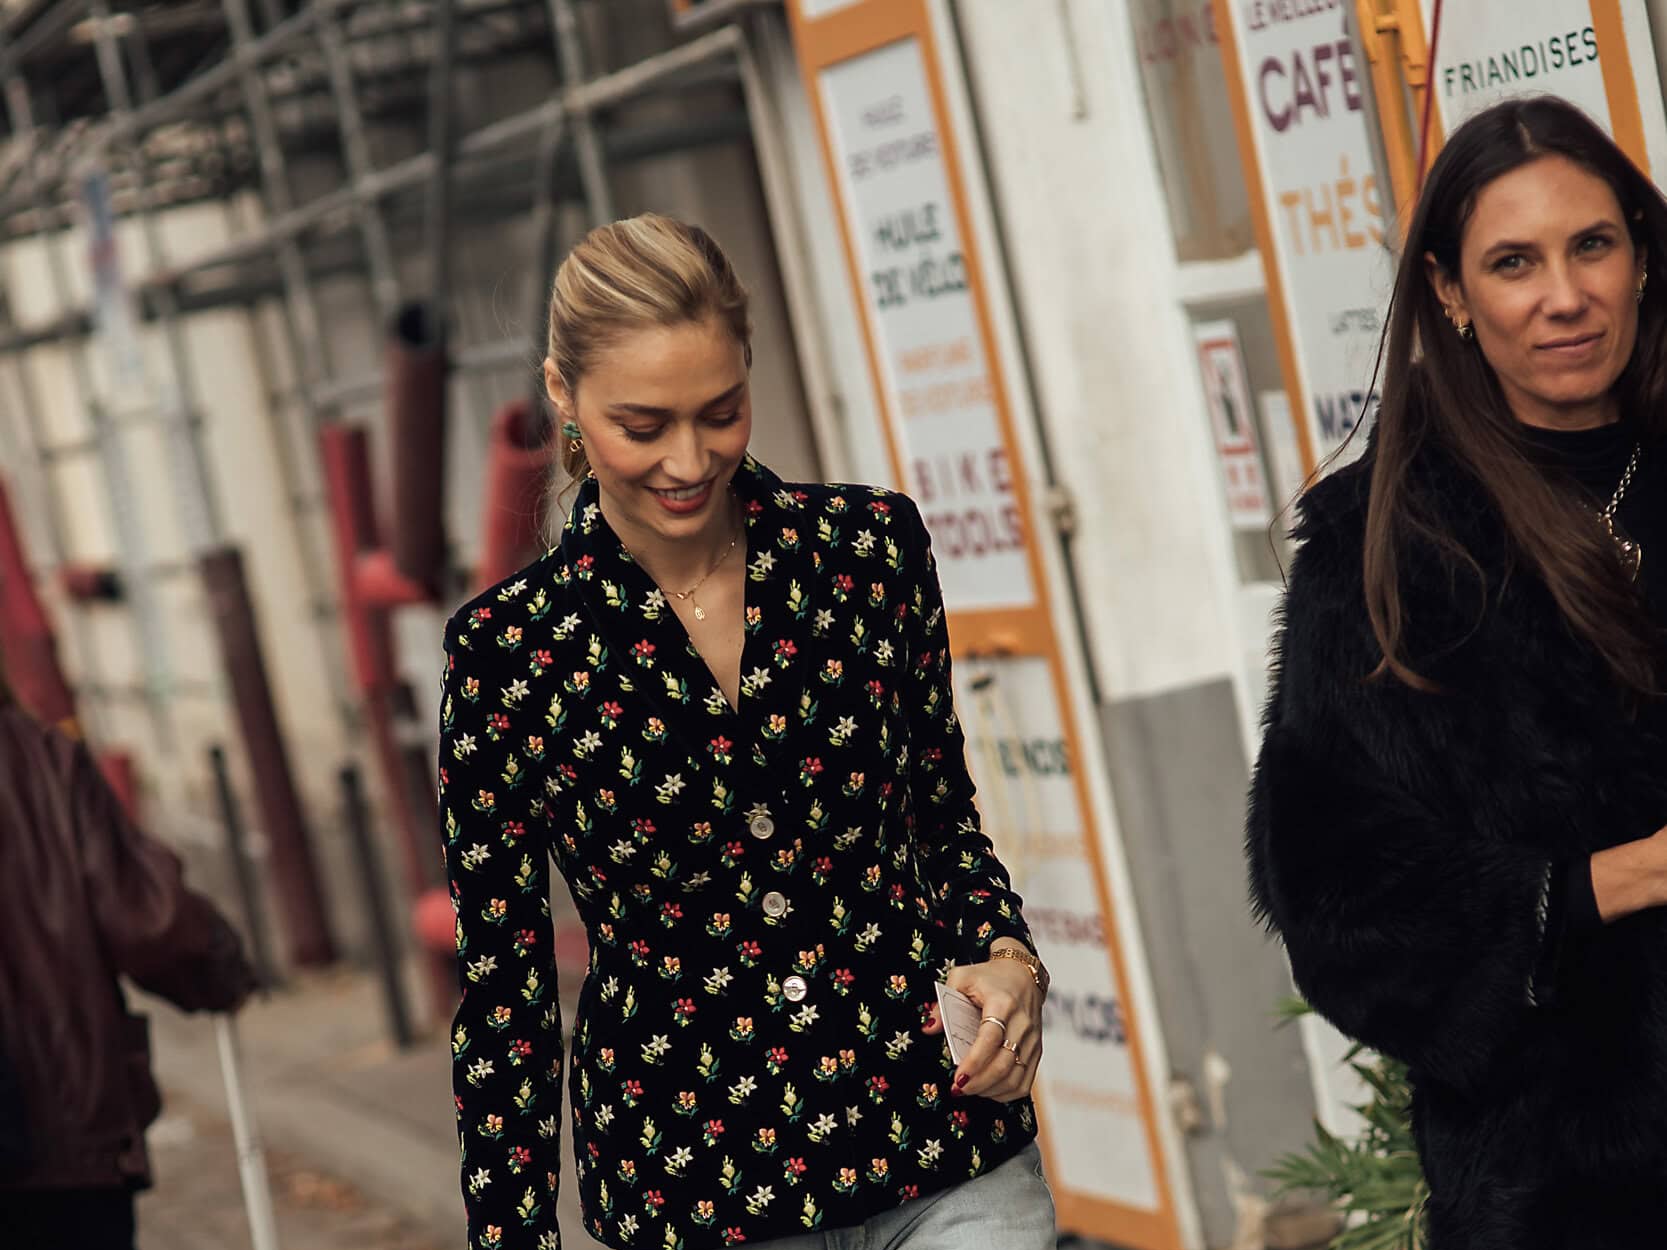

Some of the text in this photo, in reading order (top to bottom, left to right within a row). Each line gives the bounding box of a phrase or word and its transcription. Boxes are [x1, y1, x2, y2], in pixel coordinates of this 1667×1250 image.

[1258, 13, 1362, 133] CAFÉ
[1444, 27, 1599, 96] FRIANDISES
[1279, 154, 1385, 256] THÉS
